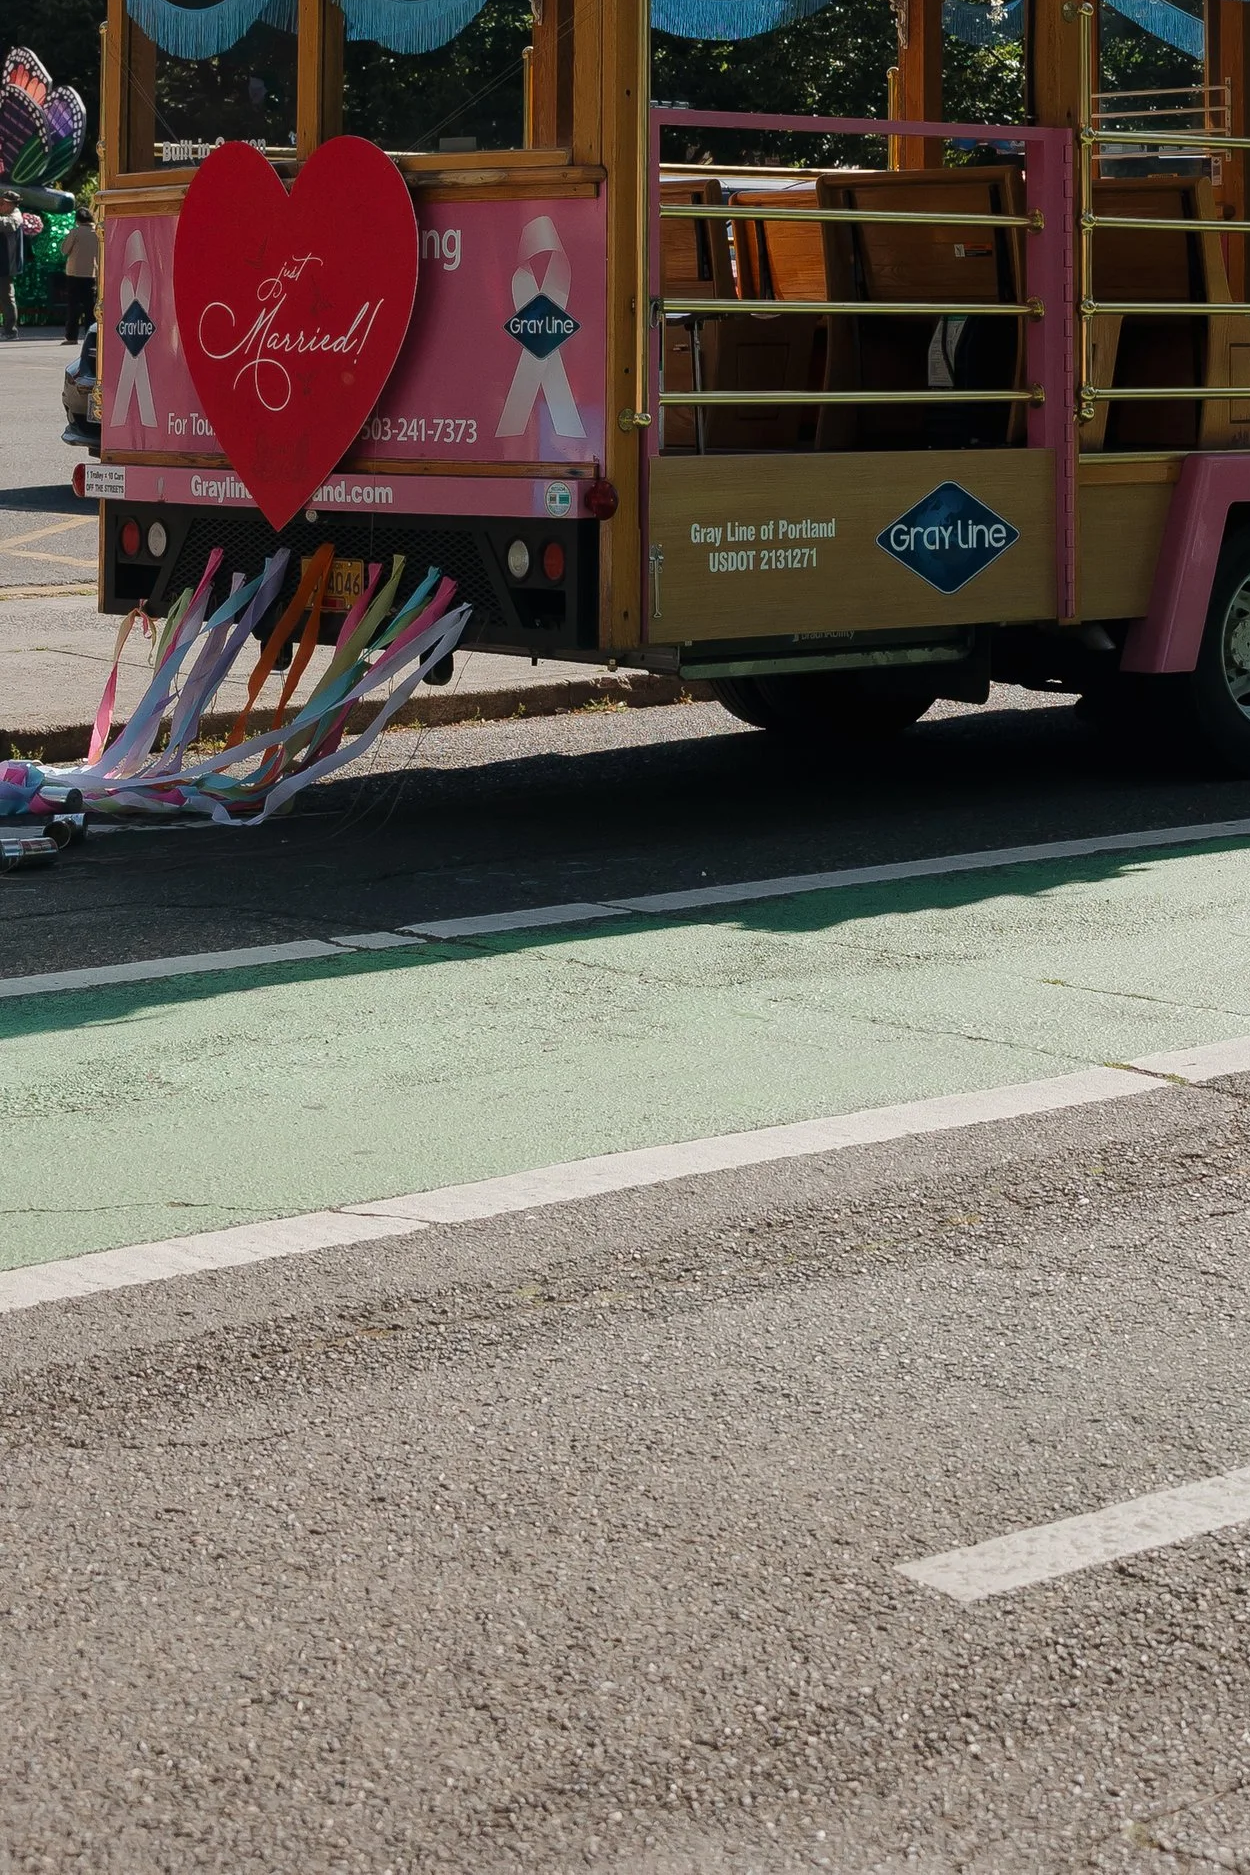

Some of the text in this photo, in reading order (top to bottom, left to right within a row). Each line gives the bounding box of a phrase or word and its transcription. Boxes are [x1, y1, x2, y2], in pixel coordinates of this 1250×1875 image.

[162, 138, 194, 162] Built
[198, 137, 211, 159] in
[256, 252, 324, 302] just
[198, 292, 385, 412] Married!
[167, 412, 216, 436] For Tou
[361, 417, 478, 444] 503-241-7373
[95, 484, 103, 493] THE
[103, 484, 124, 494] STREETS
[690, 517, 836, 547] Gray Line of Portland
[708, 547, 818, 573] USDOT 2131271
